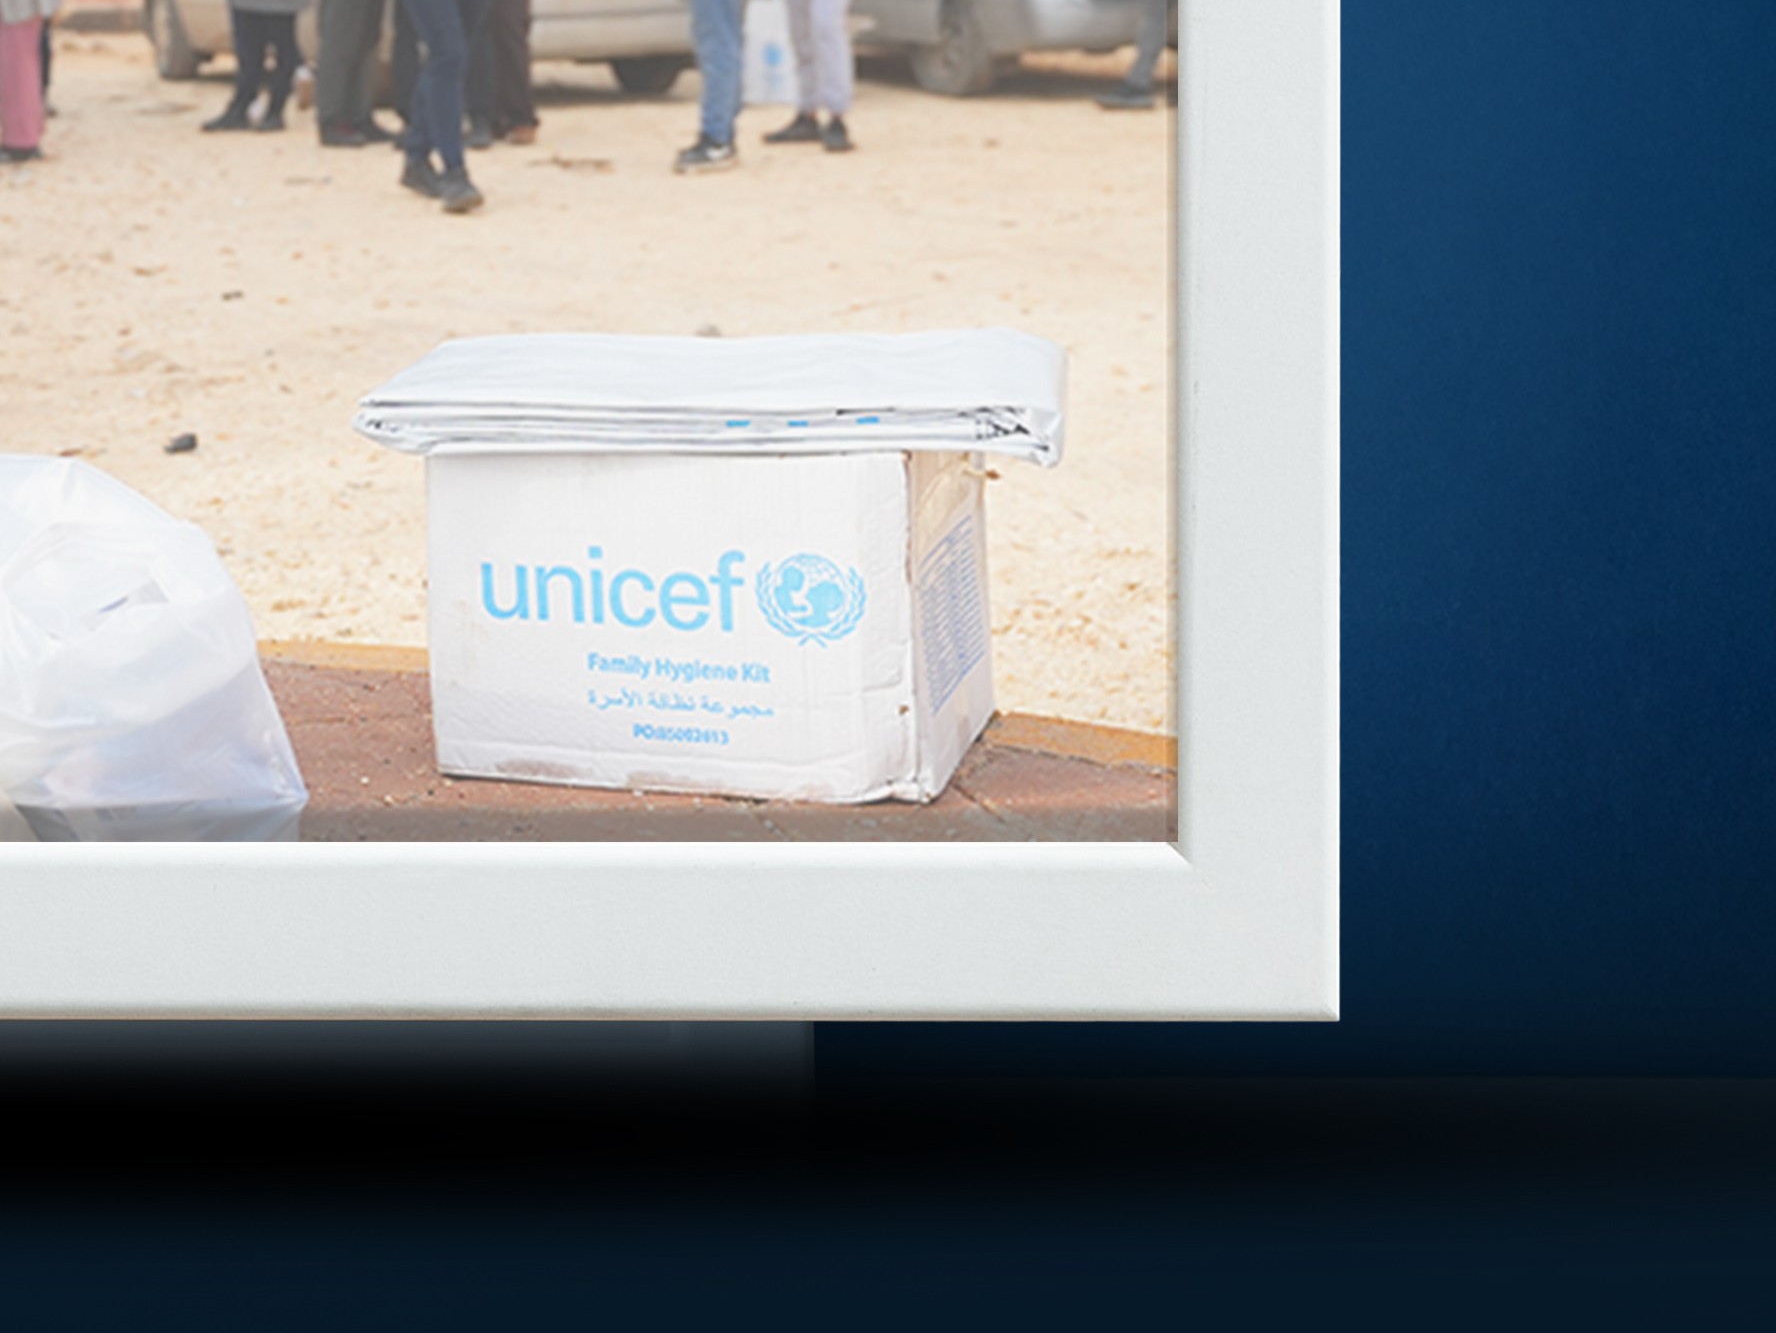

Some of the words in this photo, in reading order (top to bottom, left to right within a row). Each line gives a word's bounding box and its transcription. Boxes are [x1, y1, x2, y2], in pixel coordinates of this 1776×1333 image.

[479, 545, 745, 633] unicef
[587, 651, 651, 680] Family
[655, 658, 738, 683] Hygiene
[741, 662, 771, 683] Kit
